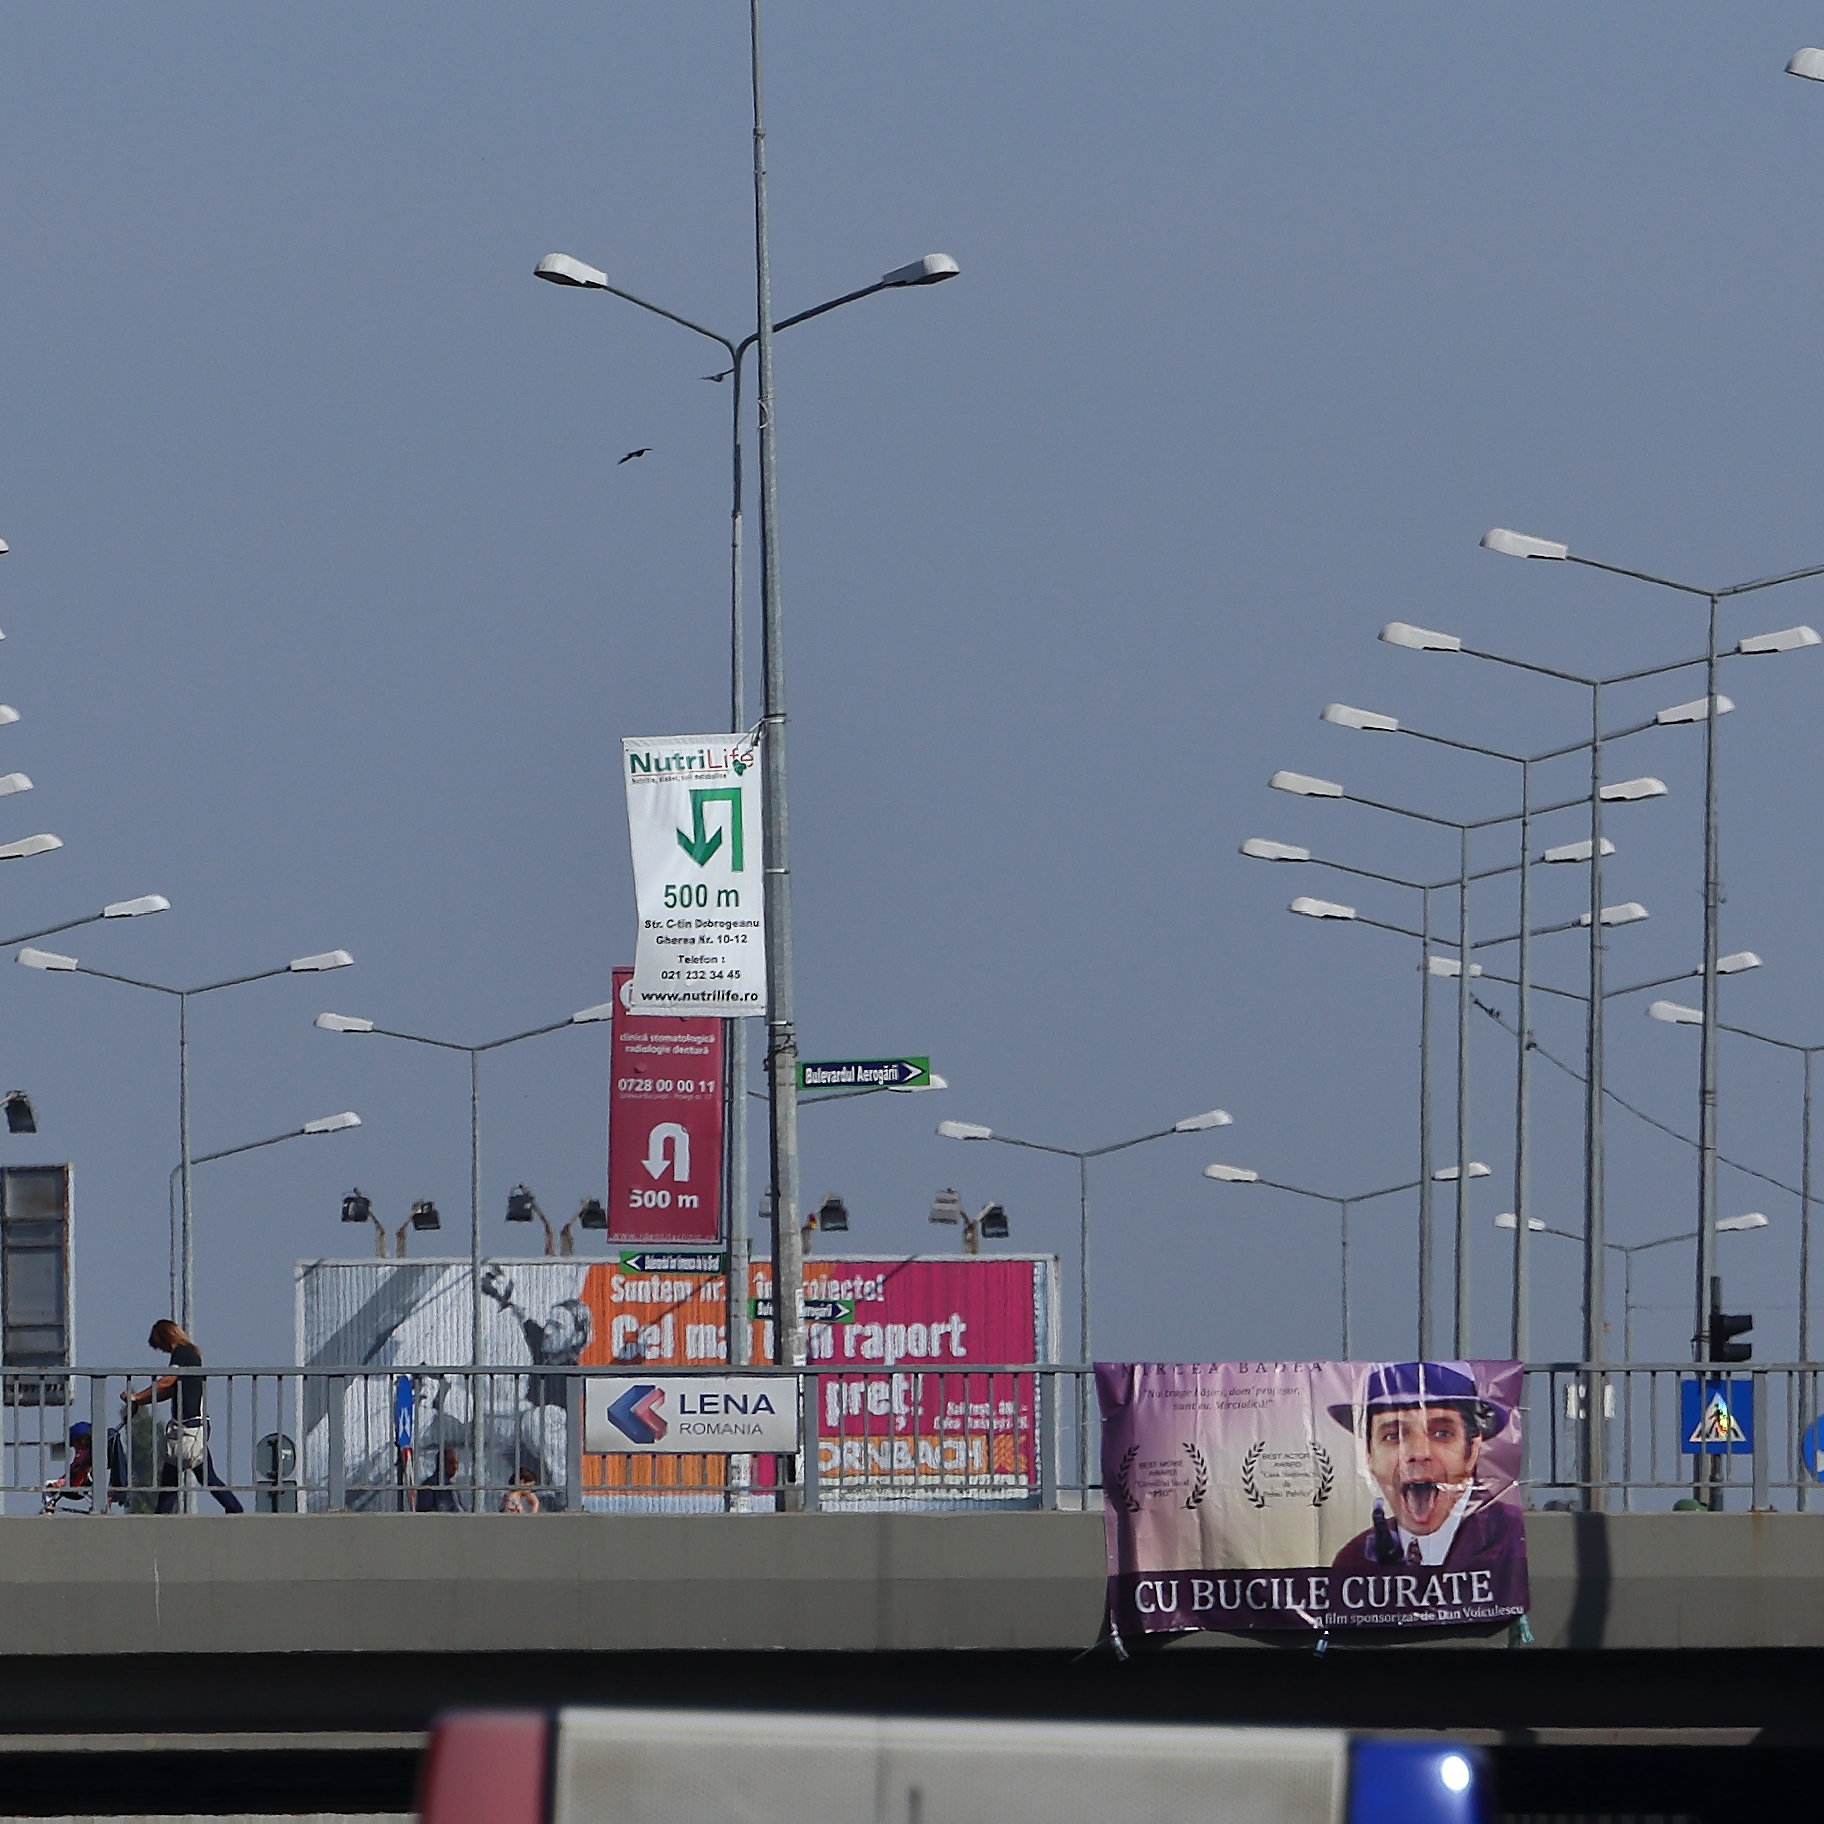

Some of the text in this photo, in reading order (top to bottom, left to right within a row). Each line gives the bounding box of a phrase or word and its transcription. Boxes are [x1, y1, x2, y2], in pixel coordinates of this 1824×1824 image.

[629, 748, 755, 774] NutriLife
[664, 884, 739, 908] 500 m
[644, 920, 663, 929] Str.
[695, 919, 760, 930] Dobrogeanu
[717, 934, 748, 943] 10-12
[678, 955, 718, 964] Telefon
[661, 970, 681, 980] 021
[686, 970, 706, 980] 232
[709, 969, 724, 979] 34
[641, 989, 759, 1002] www.nutrilife.ro
[805, 1065, 855, 1084] Bulevardul
[618, 1078, 716, 1093] 0728 00 00 11
[629, 1189, 700, 1209] 500 m
[610, 1274, 693, 1303] Suntem
[610, 1312, 675, 1360] Cel
[843, 1312, 967, 1366] raport
[1238, 1361, 1324, 1374] BADEA
[679, 1393, 776, 1415] LENA
[679, 1421, 764, 1436] ROMANIA
[1135, 1570, 1494, 1614] CU BUCILE CURATE
[1325, 1614, 1348, 1625] film
[1437, 1609, 1461, 1621] Dan
[1463, 1604, 1525, 1620] Voiculescu
